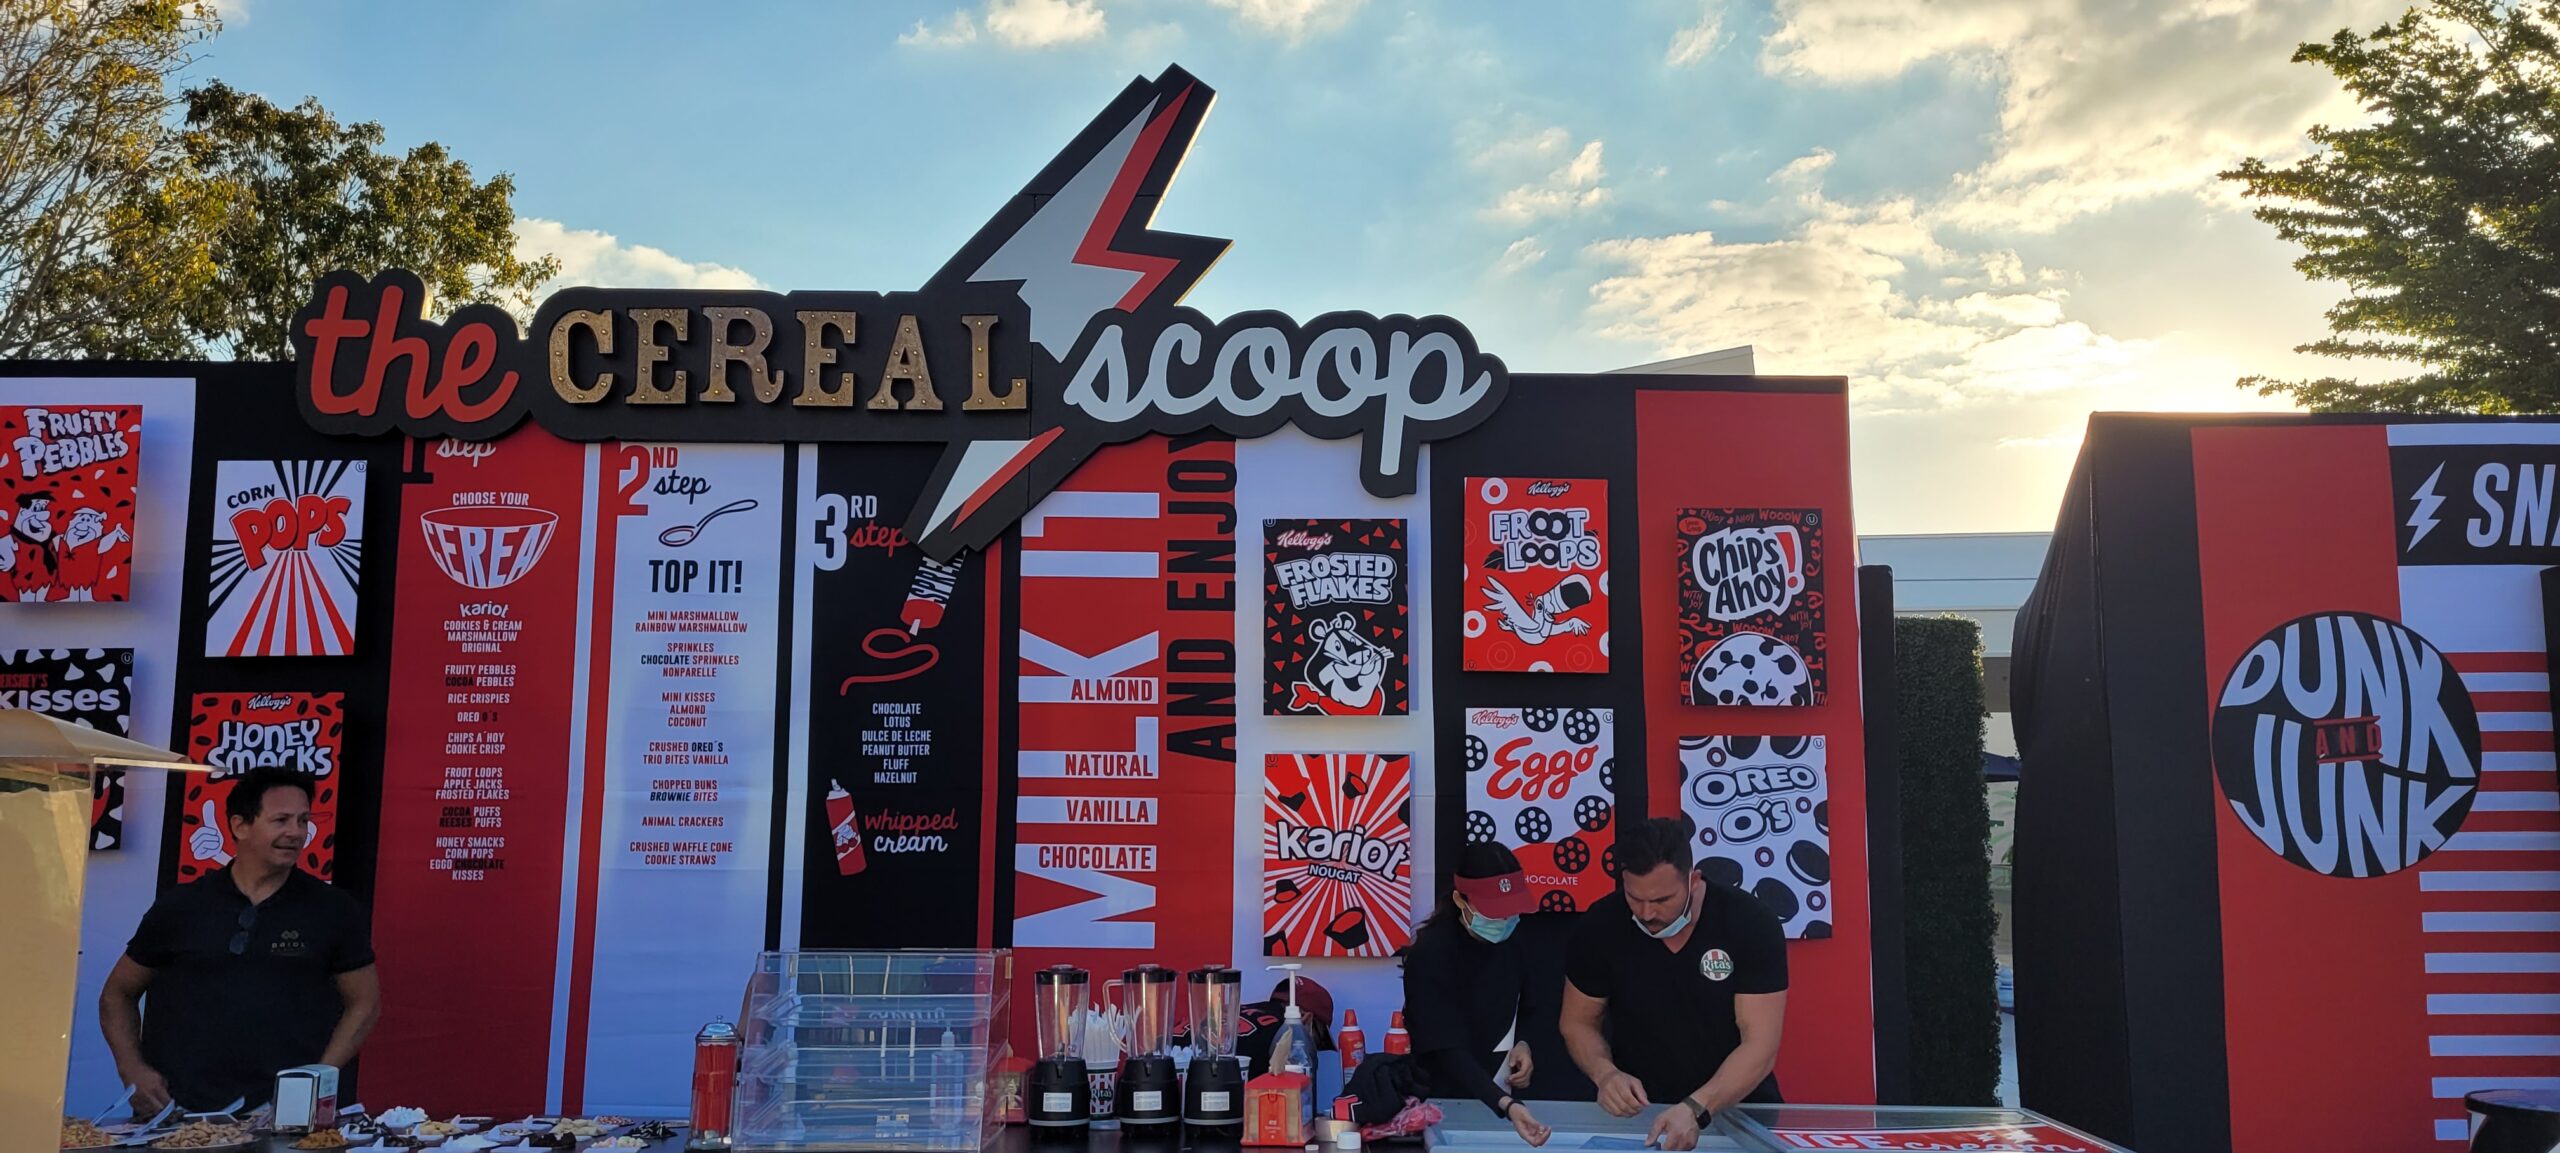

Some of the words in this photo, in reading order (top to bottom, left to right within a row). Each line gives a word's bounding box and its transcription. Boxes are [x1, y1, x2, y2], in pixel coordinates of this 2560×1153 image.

[305, 285, 519, 423] the
[549, 306, 1027, 411] CEREAL
[1063, 323, 1491, 475] scoop
[24, 408, 117, 438] FRUITY
[13, 431, 129, 478] PEBBLES
[436, 437, 496, 468] step
[653, 470, 711, 505] step
[1527, 481, 1570, 496] Kellogg's
[226, 484, 275, 509] CORN
[452, 491, 496, 506] CHOOSE
[500, 491, 529, 506] YOUR
[1490, 509, 1588, 542] FROOT
[229, 493, 352, 572] POPS
[850, 520, 909, 557] step
[1277, 529, 1333, 550] Kellogg's
[422, 519, 557, 588] CEREAL
[1505, 538, 1600, 571] LOOPS
[1700, 536, 1780, 586] Chips
[649, 560, 698, 592] TOP
[708, 560, 743, 593] IT!
[1275, 553, 1395, 587] FROSTED
[1290, 576, 1391, 606] FLAKES
[460, 601, 509, 618] kariot
[648, 611, 667, 620] MINI
[670, 611, 739, 620] MARSHMALLOW
[444, 620, 480, 631] COOKIES
[484, 620, 490, 631] &
[492, 620, 522, 631] CREAM
[635, 622, 676, 632] RAINBOW
[678, 622, 748, 632] MARSHMALLOW
[448, 632, 518, 642] MARSHMALLOW
[462, 642, 502, 653] ORIGINAL
[667, 642, 714, 652] SPRINKLES
[640, 654, 690, 665] CHOCOLATE
[692, 655, 740, 665] SPRINKLES
[445, 664, 476, 675] FRUITY
[478, 664, 516, 675] PEBBLES
[445, 676, 474, 687] COCOA
[476, 676, 514, 687] PEBBLES
[1071, 679, 1152, 701] ALMOND
[2220, 615, 2476, 778] DUNK
[248, 694, 292, 710] Kellogg's
[448, 693, 468, 704] RICE
[470, 693, 510, 704] CRISPIES
[662, 692, 682, 702] MINI
[684, 692, 716, 702] KISSES
[1166, 638, 1237, 763] AND
[670, 704, 706, 714] ALMOND
[872, 703, 922, 714] CHOCOLATE
[458, 712, 480, 722] OREO
[668, 717, 708, 727] COCONUT
[884, 716, 910, 728] LOTUS
[1472, 710, 1519, 728] Kellogg's
[448, 732, 474, 743] CHIPS
[862, 730, 888, 742] DULCE
[892, 730, 902, 742] DE
[905, 730, 932, 742] LECHE
[2315, 723, 2382, 759] AND
[446, 744, 477, 754] COOKIE
[480, 744, 506, 754] CRISP
[650, 742, 688, 752] CRUSHED
[862, 744, 895, 756] PEANUT
[898, 744, 930, 756] BUTTER
[643, 754, 662, 764] TRIO
[666, 754, 690, 764] BITES
[692, 754, 728, 764] VANILLA
[884, 758, 910, 770] FLUFF
[1065, 754, 1153, 776] NATURAL
[445, 767, 472, 778] FROOT
[475, 767, 502, 778] LOOPS
[1486, 736, 1600, 801] Eggo
[444, 779, 472, 789] APPLE
[474, 779, 502, 789] JACKS
[874, 772, 918, 784] HAZELNUT
[652, 780, 692, 790] CHOPPED
[694, 780, 718, 790] BUNS
[1012, 628, 1159, 949] MILK
[1692, 765, 1817, 807] OREO
[436, 790, 474, 800] FROSTED
[476, 790, 510, 800] FLAKES
[650, 792, 690, 802] BROWNIE
[693, 792, 718, 802] BITES
[2229, 713, 2476, 877] JUNK
[474, 806, 500, 816] PUFFS
[1066, 800, 1150, 822] VANILLA
[474, 818, 502, 828] PUFFS
[642, 816, 676, 826] ANIMAL
[678, 816, 724, 826] CRACKERS
[865, 808, 958, 835] whipped
[1720, 798, 1794, 843] O'S
[436, 837, 465, 848] HONEY
[468, 837, 504, 848] SMACKS
[630, 842, 670, 852] CRUSHED
[672, 842, 708, 852] WAFFLE
[710, 842, 733, 852] CONE
[874, 835, 948, 853] cream
[445, 848, 468, 859] CORN
[471, 848, 494, 859] POPS
[1277, 820, 1410, 882] kariot
[645, 854, 676, 864] COOKIE
[679, 854, 716, 864] STRAWS
[1038, 846, 1152, 870] CHOCOLATE
[430, 860, 452, 870] EGGO
[452, 870, 484, 880] KISSES
[1308, 863, 1361, 884] NOUGAT
[1525, 874, 1579, 887] HOCOLATE
[1703, 959, 1731, 972] Rita's
[1784, 1133, 1903, 1149] ICE
